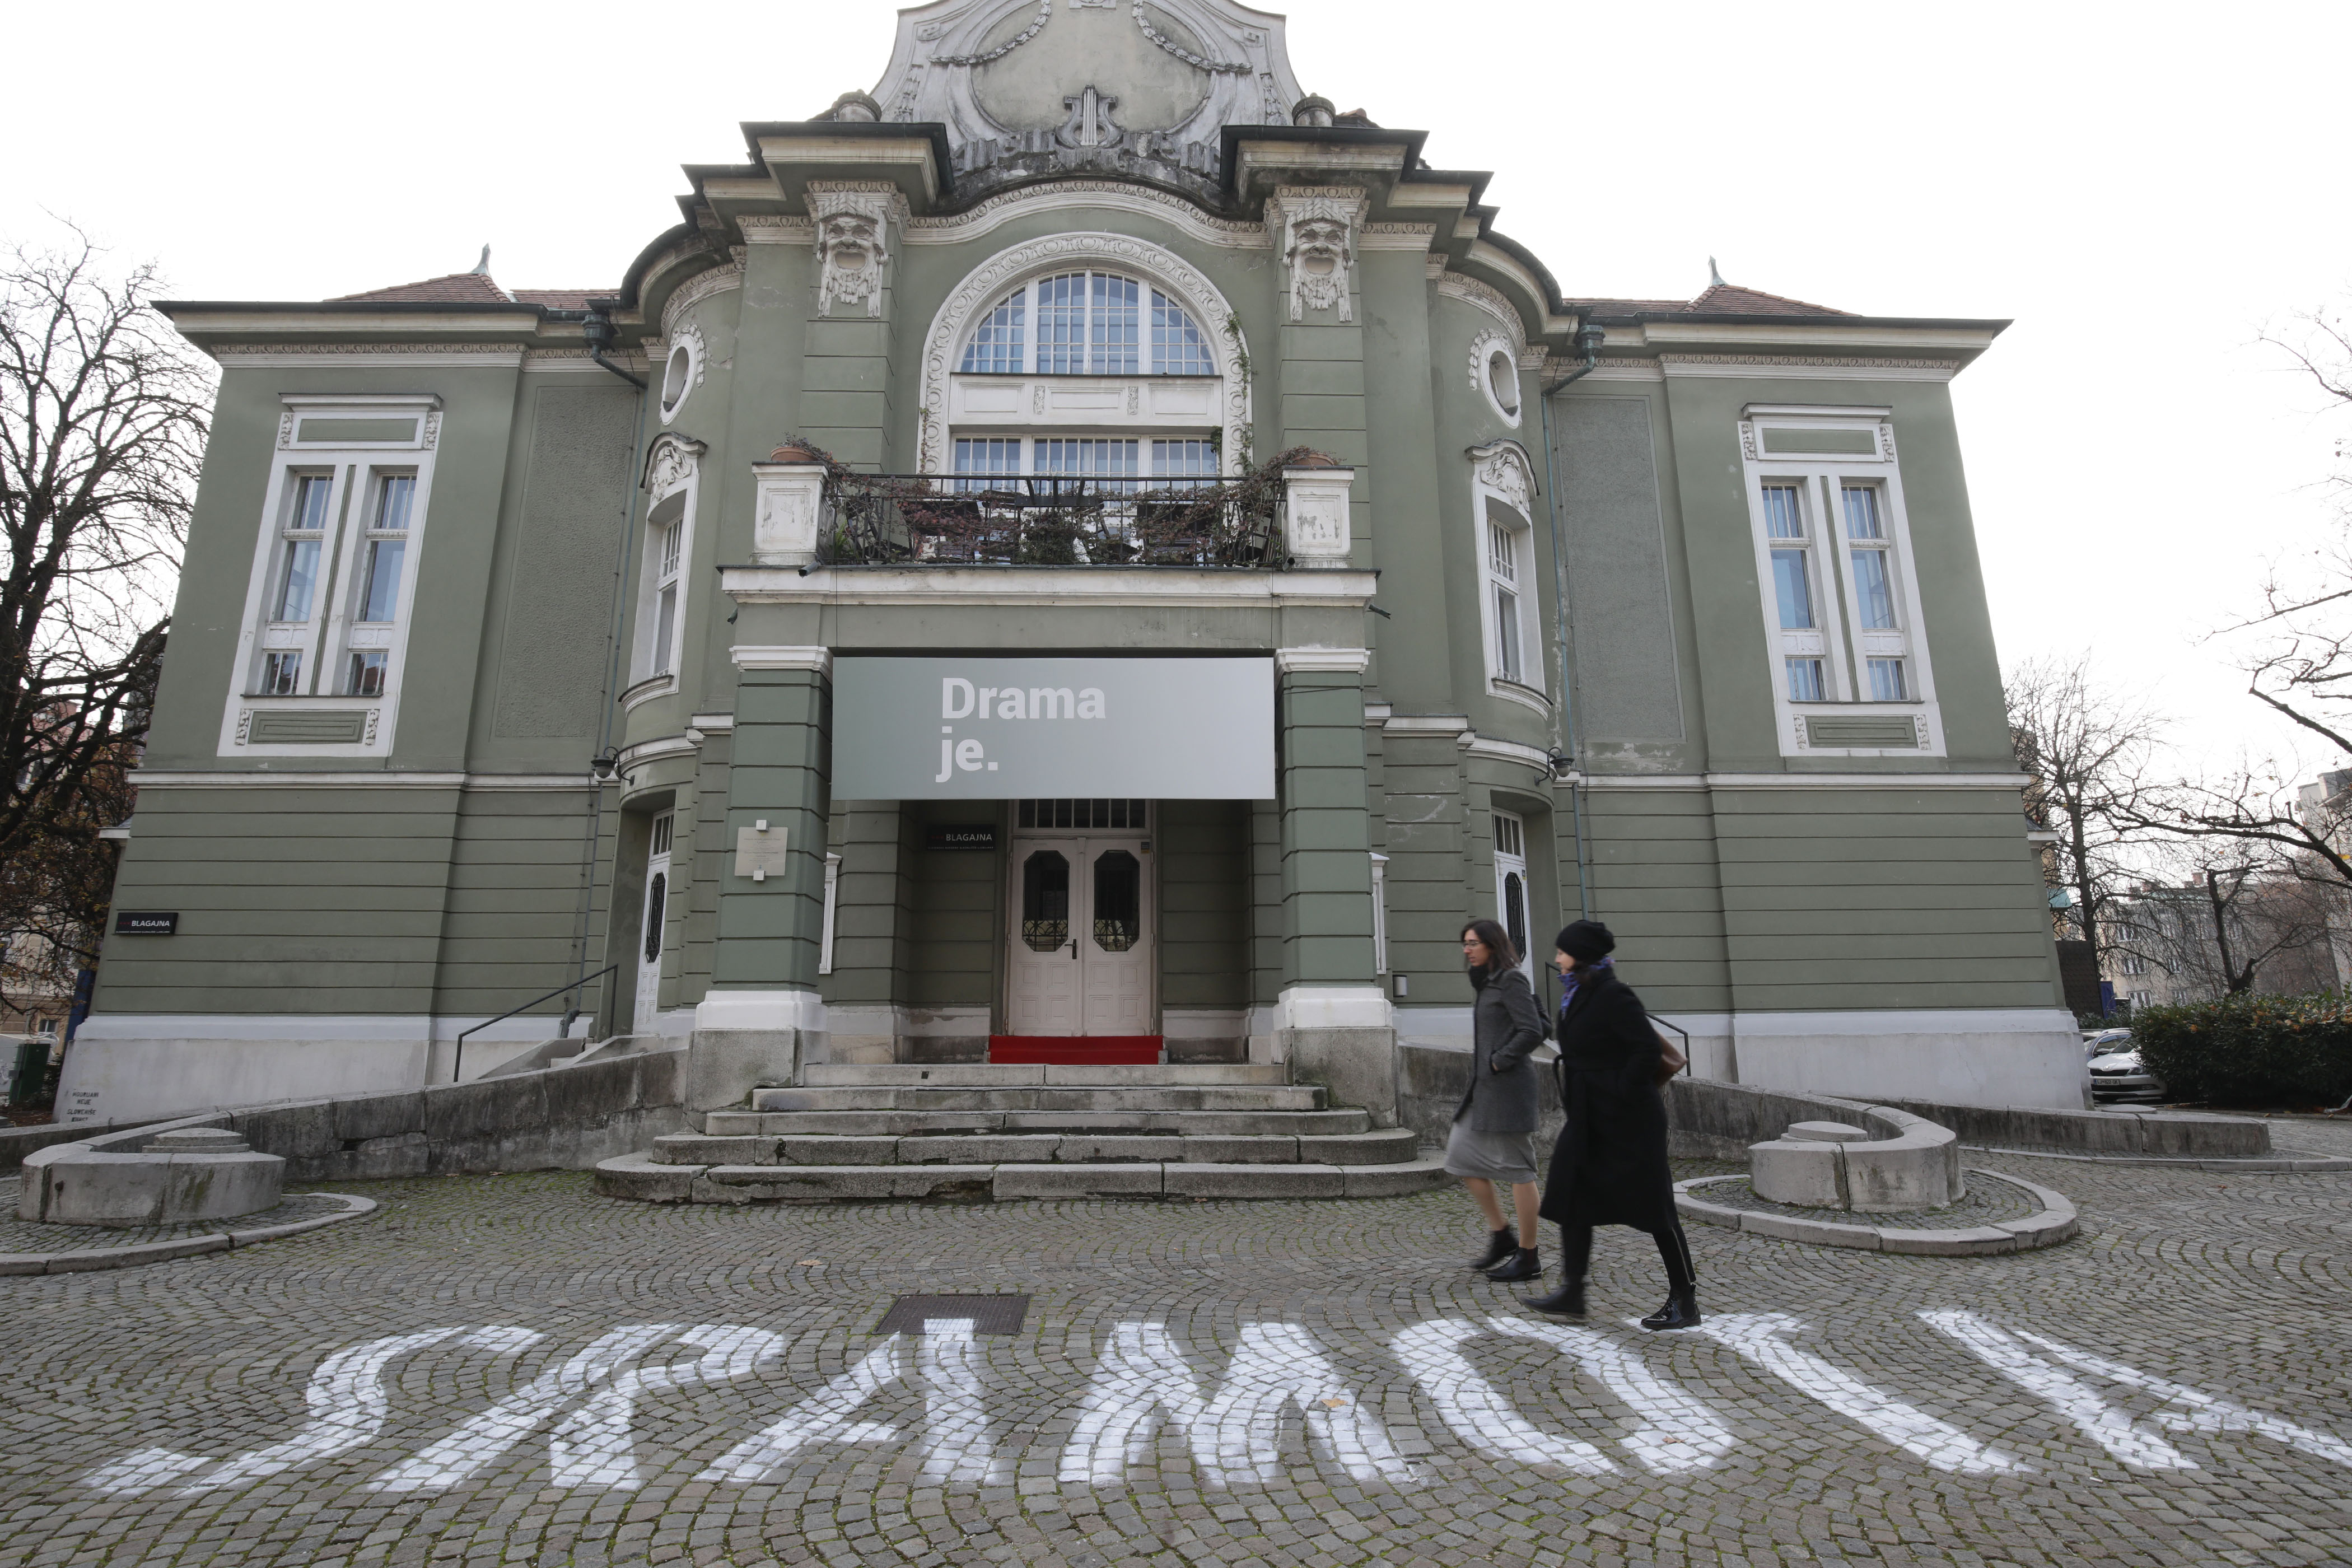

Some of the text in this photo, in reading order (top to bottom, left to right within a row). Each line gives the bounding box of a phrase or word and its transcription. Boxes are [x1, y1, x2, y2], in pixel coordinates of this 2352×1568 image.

[942, 678, 1106, 720] Drama
[935, 726, 998, 782] je.
[83, 1309, 2352, 1495] SRAMOTA
